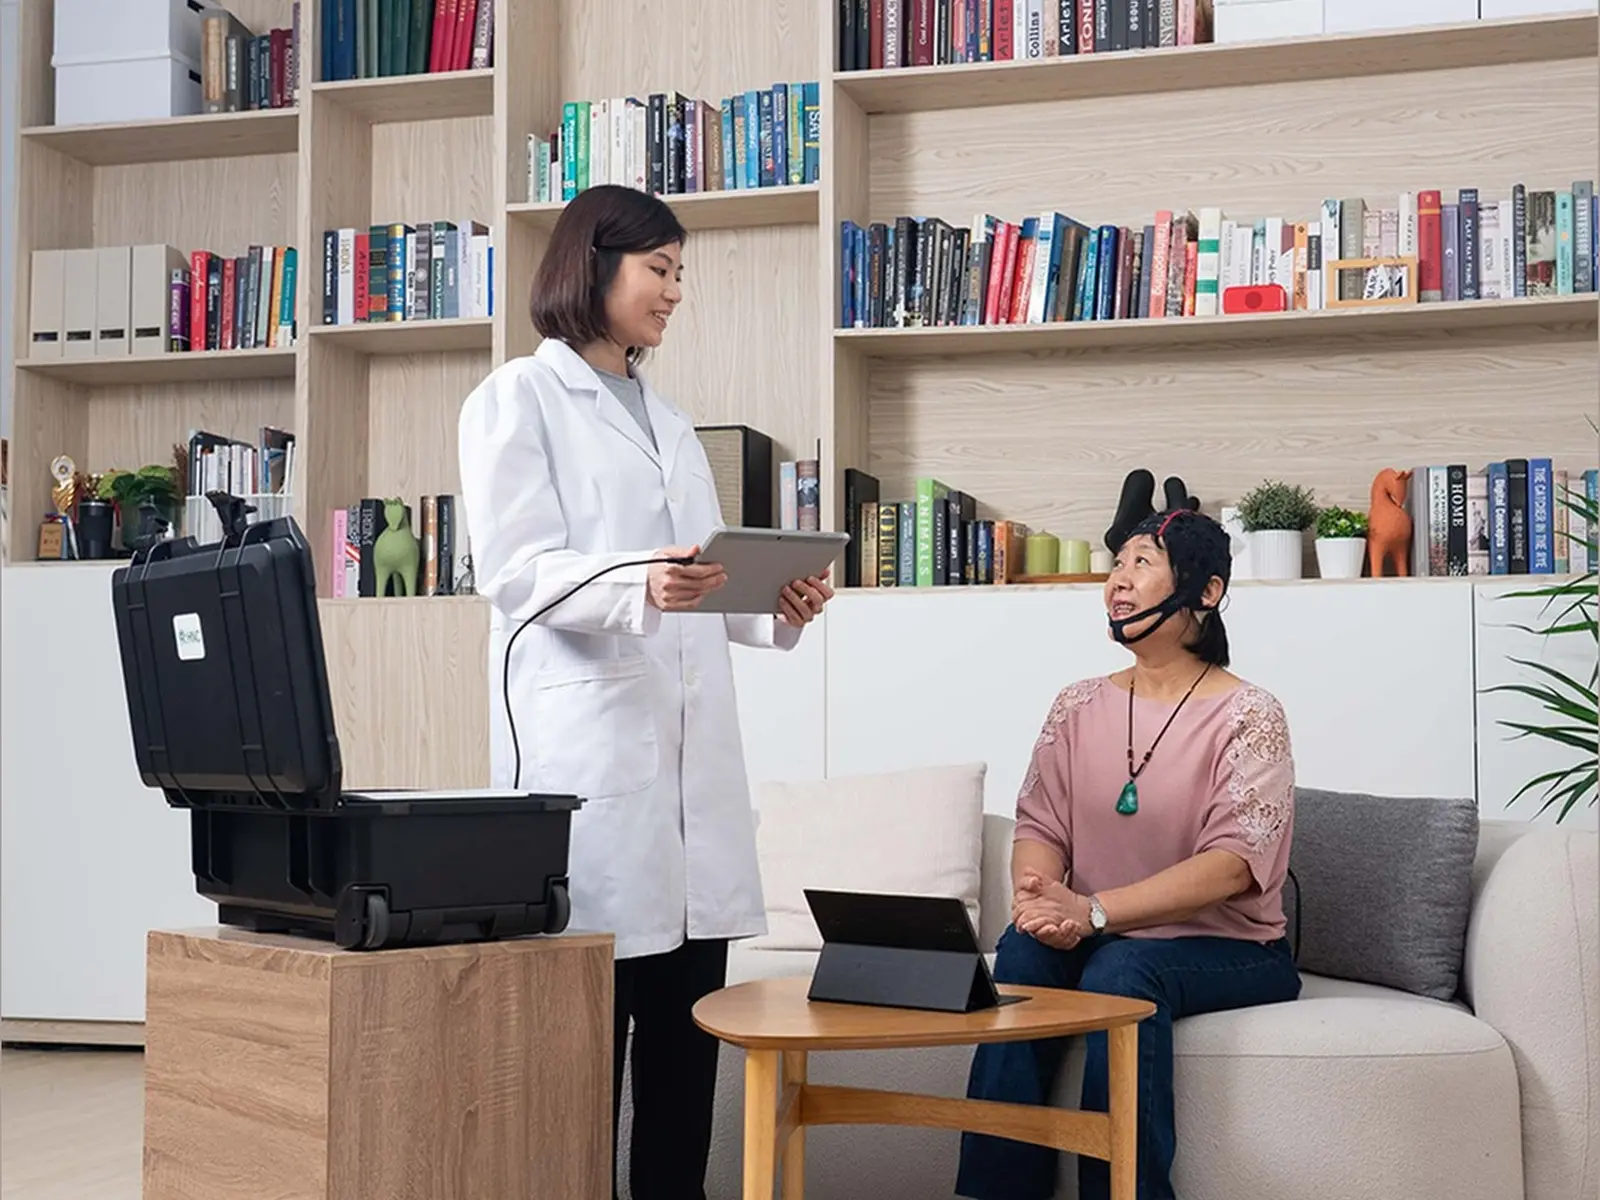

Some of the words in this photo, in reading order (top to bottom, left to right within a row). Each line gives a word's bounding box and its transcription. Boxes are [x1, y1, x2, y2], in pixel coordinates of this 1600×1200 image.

[886, 30, 898, 67] HOME
[1029, 11, 1040, 58] Collins
[1534, 467, 1546, 484] THE
[1452, 483, 1464, 527] HOME
[1534, 484, 1547, 522] CATCHER
[919, 493, 930, 577] ANIMALS
[1535, 551, 1547, 568] RYE
